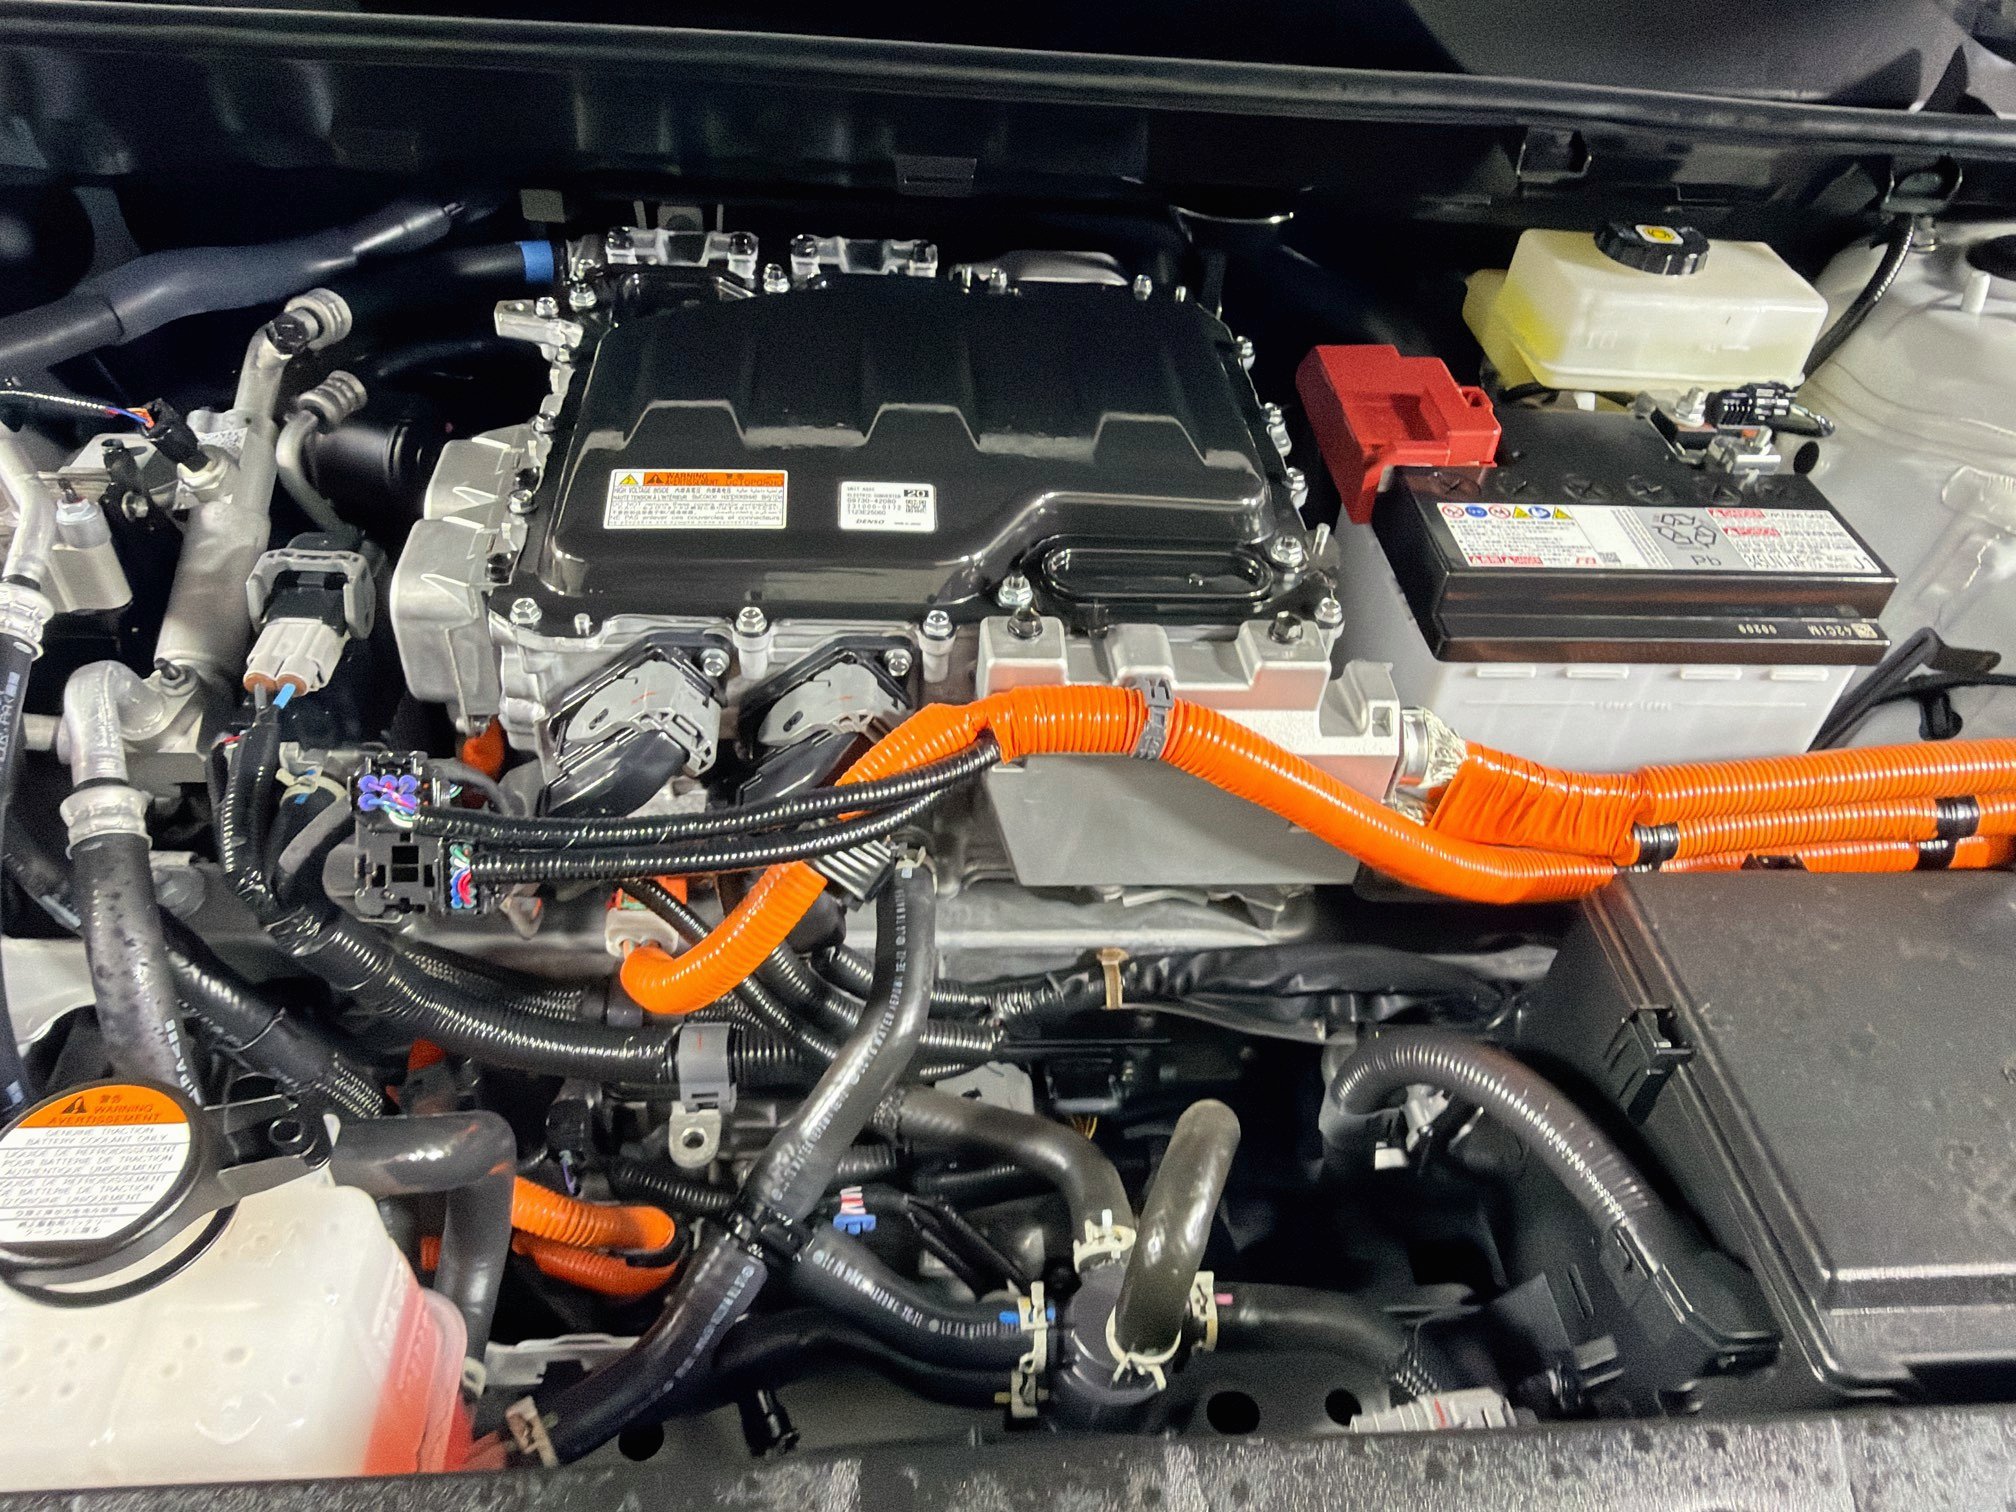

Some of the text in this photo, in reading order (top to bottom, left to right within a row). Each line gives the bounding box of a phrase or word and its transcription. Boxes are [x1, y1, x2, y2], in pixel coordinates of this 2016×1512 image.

[1691, 554, 1722, 566] Pb
[94, 1104, 154, 1114] WARNING
[48, 1114, 160, 1124] AVERTISSEMENT
